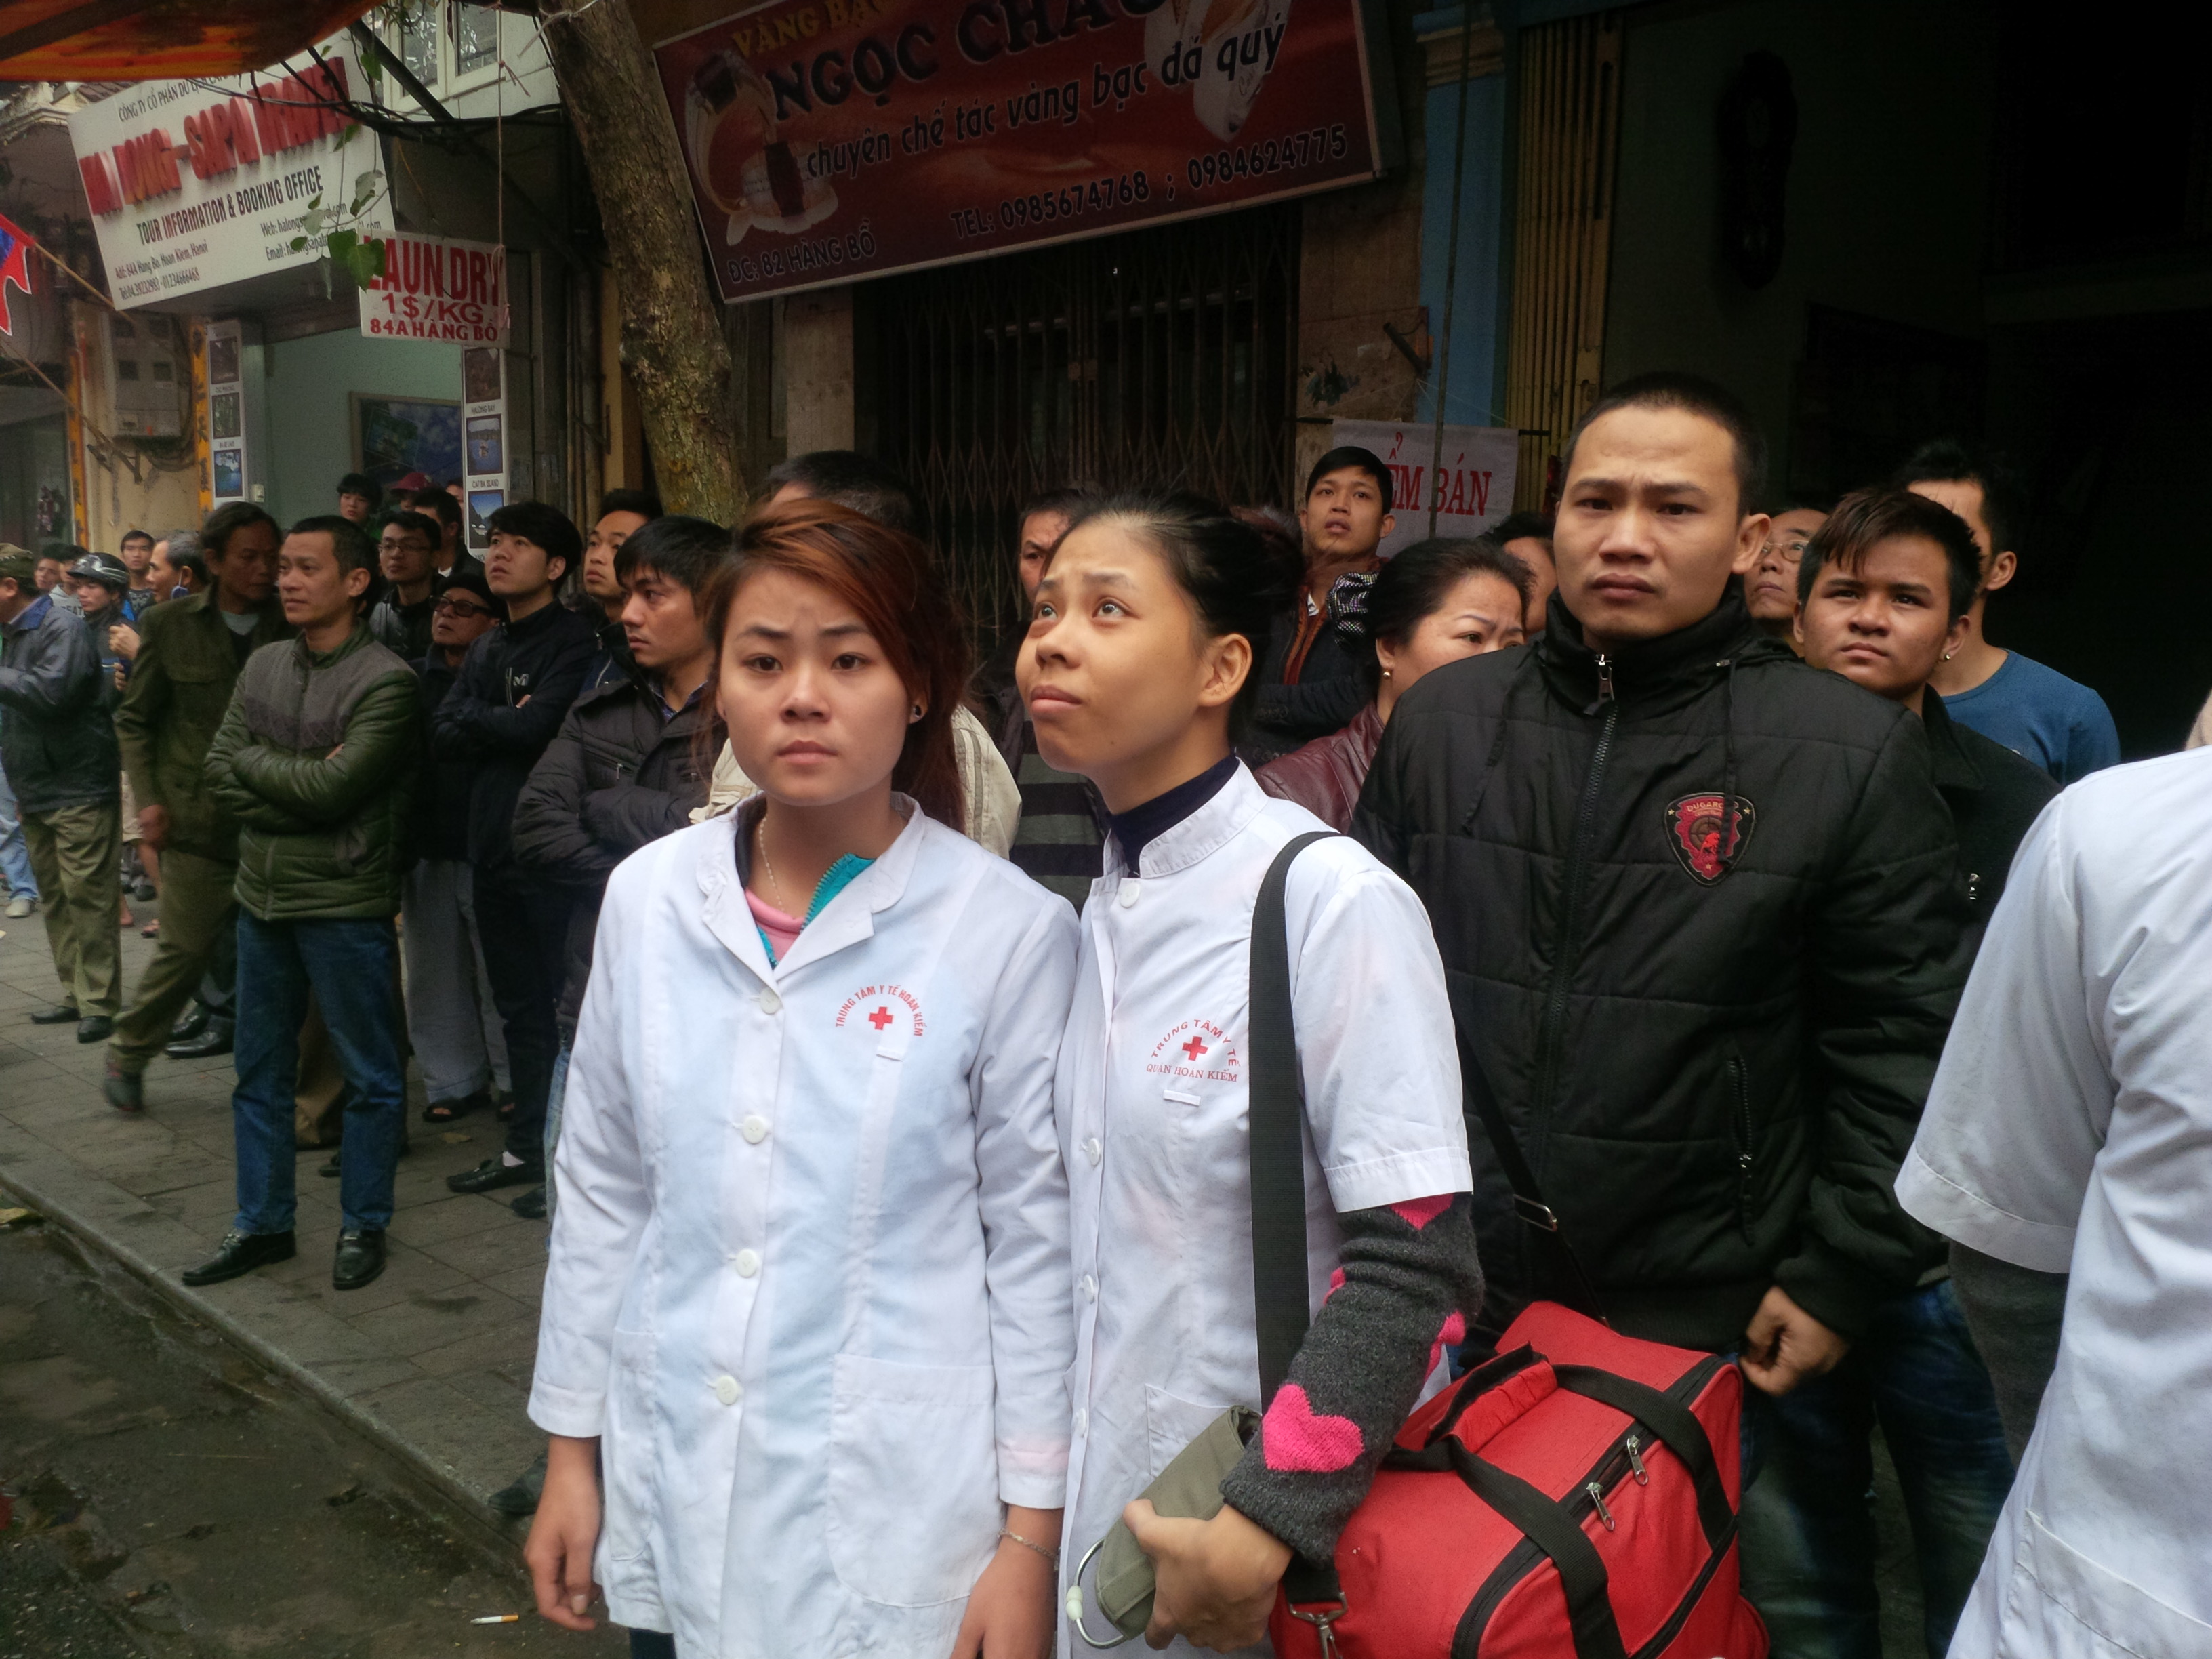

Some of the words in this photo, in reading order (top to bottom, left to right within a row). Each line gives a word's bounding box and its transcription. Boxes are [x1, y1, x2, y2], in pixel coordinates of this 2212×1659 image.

[733, 7, 821, 58] VÀNG
[764, 23, 939, 121] NGỌC
[956, 0, 1167, 64] CHA
[807, 127, 891, 178] chuyên
[901, 99, 947, 154] chế
[956, 99, 996, 140] tác
[1007, 83, 1080, 126] vàng
[1092, 62, 1148, 112] bạc
[1217, 12, 1286, 82] quý
[136, 218, 163, 245] TOUR
[161, 197, 228, 239] INFORMATION
[227, 193, 237, 218] &
[235, 178, 284, 216] BOOKING
[284, 165, 324, 201] OFFICE
[950, 207, 996, 239] TEL:
[1000, 170, 1150, 229] 0985674768
[1187, 124, 1348, 190] 0984624775
[761, 249, 785, 277] 82
[786, 237, 844, 272] HÀNG
[370, 318, 409, 336] 84A
[412, 319, 469, 341] HÀNG
[836, 998, 856, 1027] TRUNG
[880, 985, 885, 994] Y
[1151, 1021, 1188, 1058] TRUNG
